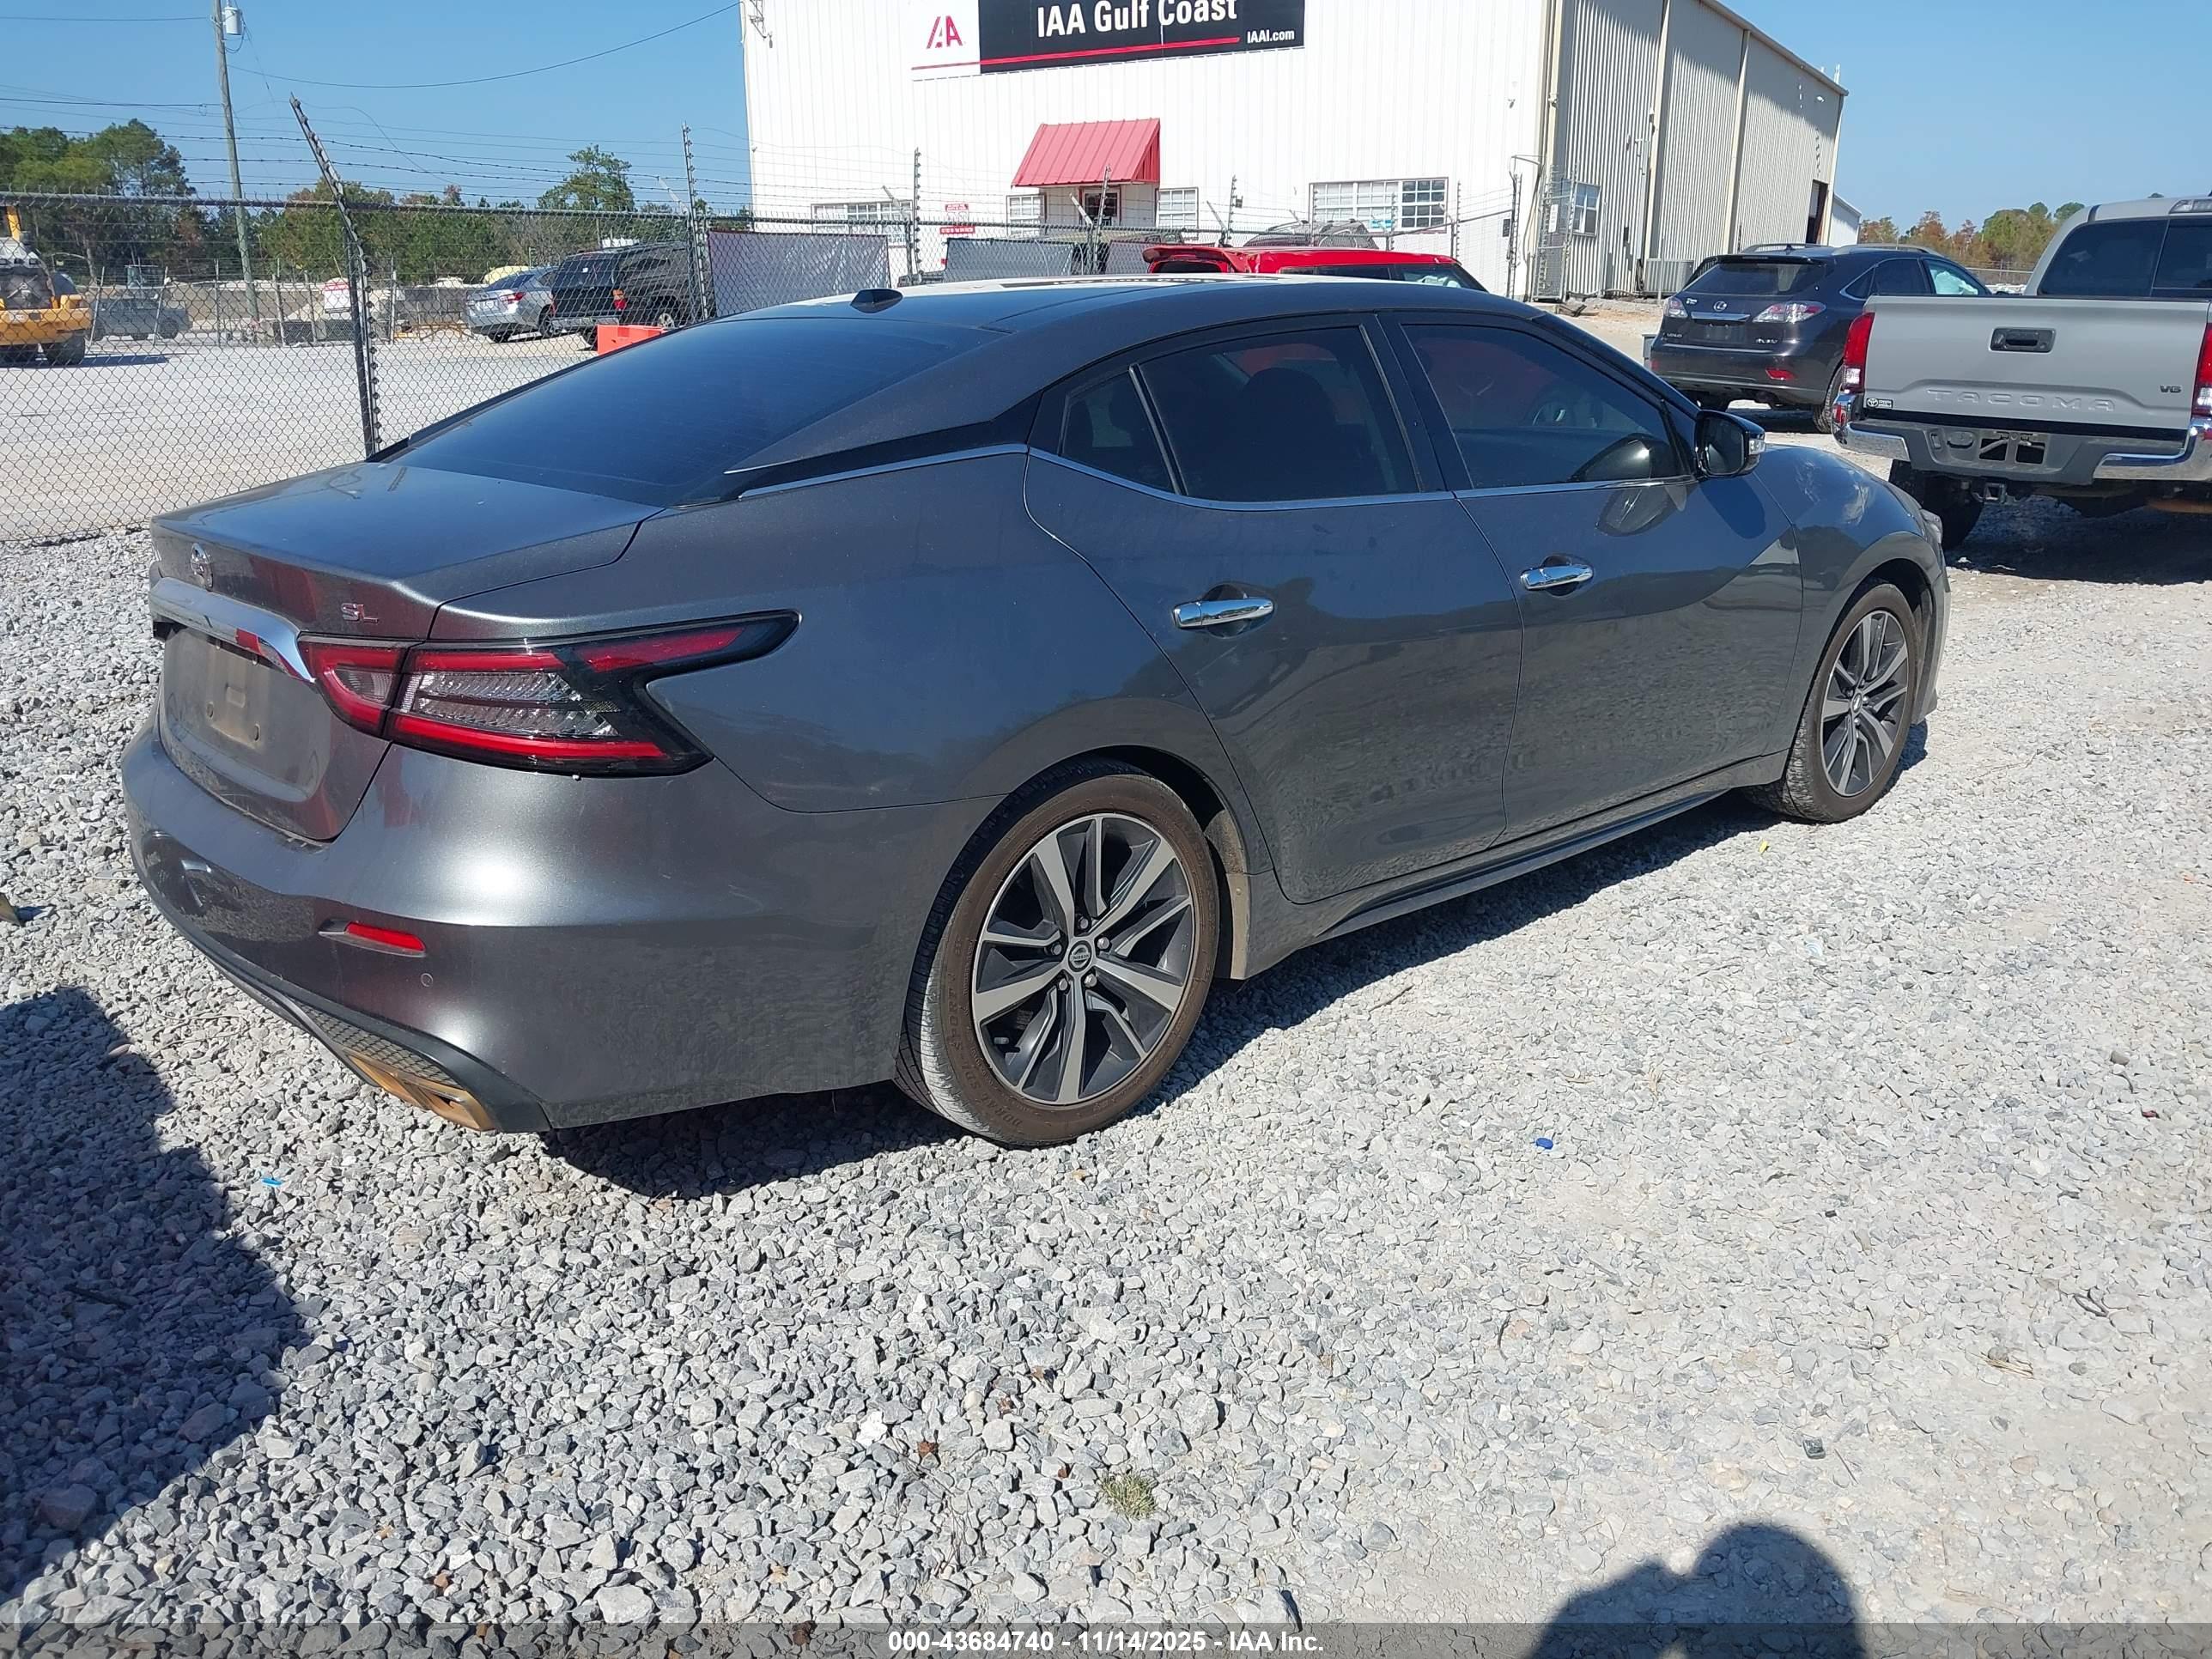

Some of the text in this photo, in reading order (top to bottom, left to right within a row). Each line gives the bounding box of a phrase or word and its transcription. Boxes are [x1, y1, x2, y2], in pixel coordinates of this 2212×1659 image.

[1037, 0, 1237, 38] IAA Gulf Coast
[1247, 29, 1295, 44] IAAI.com
[1927, 388, 2115, 412] TACOMA
[341, 602, 379, 623] SL
